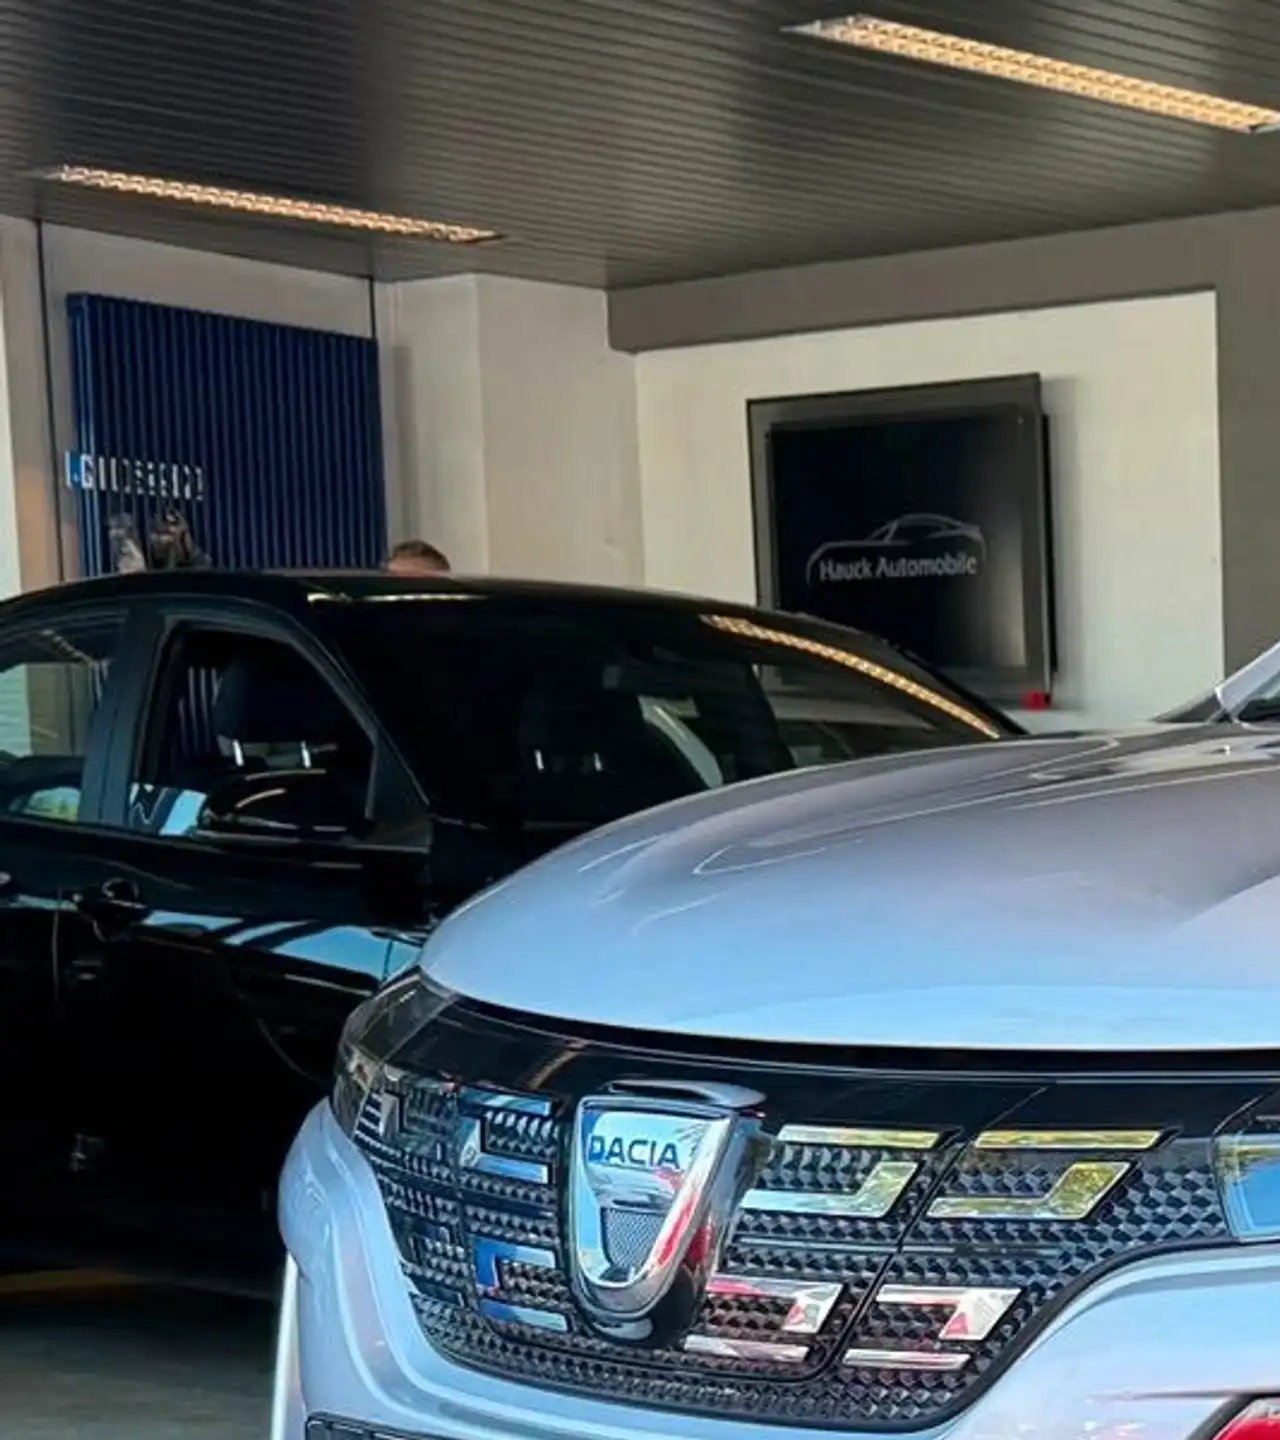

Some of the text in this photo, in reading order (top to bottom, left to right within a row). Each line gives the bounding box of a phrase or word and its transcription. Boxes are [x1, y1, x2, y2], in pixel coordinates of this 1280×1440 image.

[819, 552, 977, 581] Hauck Automobile
[588, 1134, 680, 1169] DACIA
